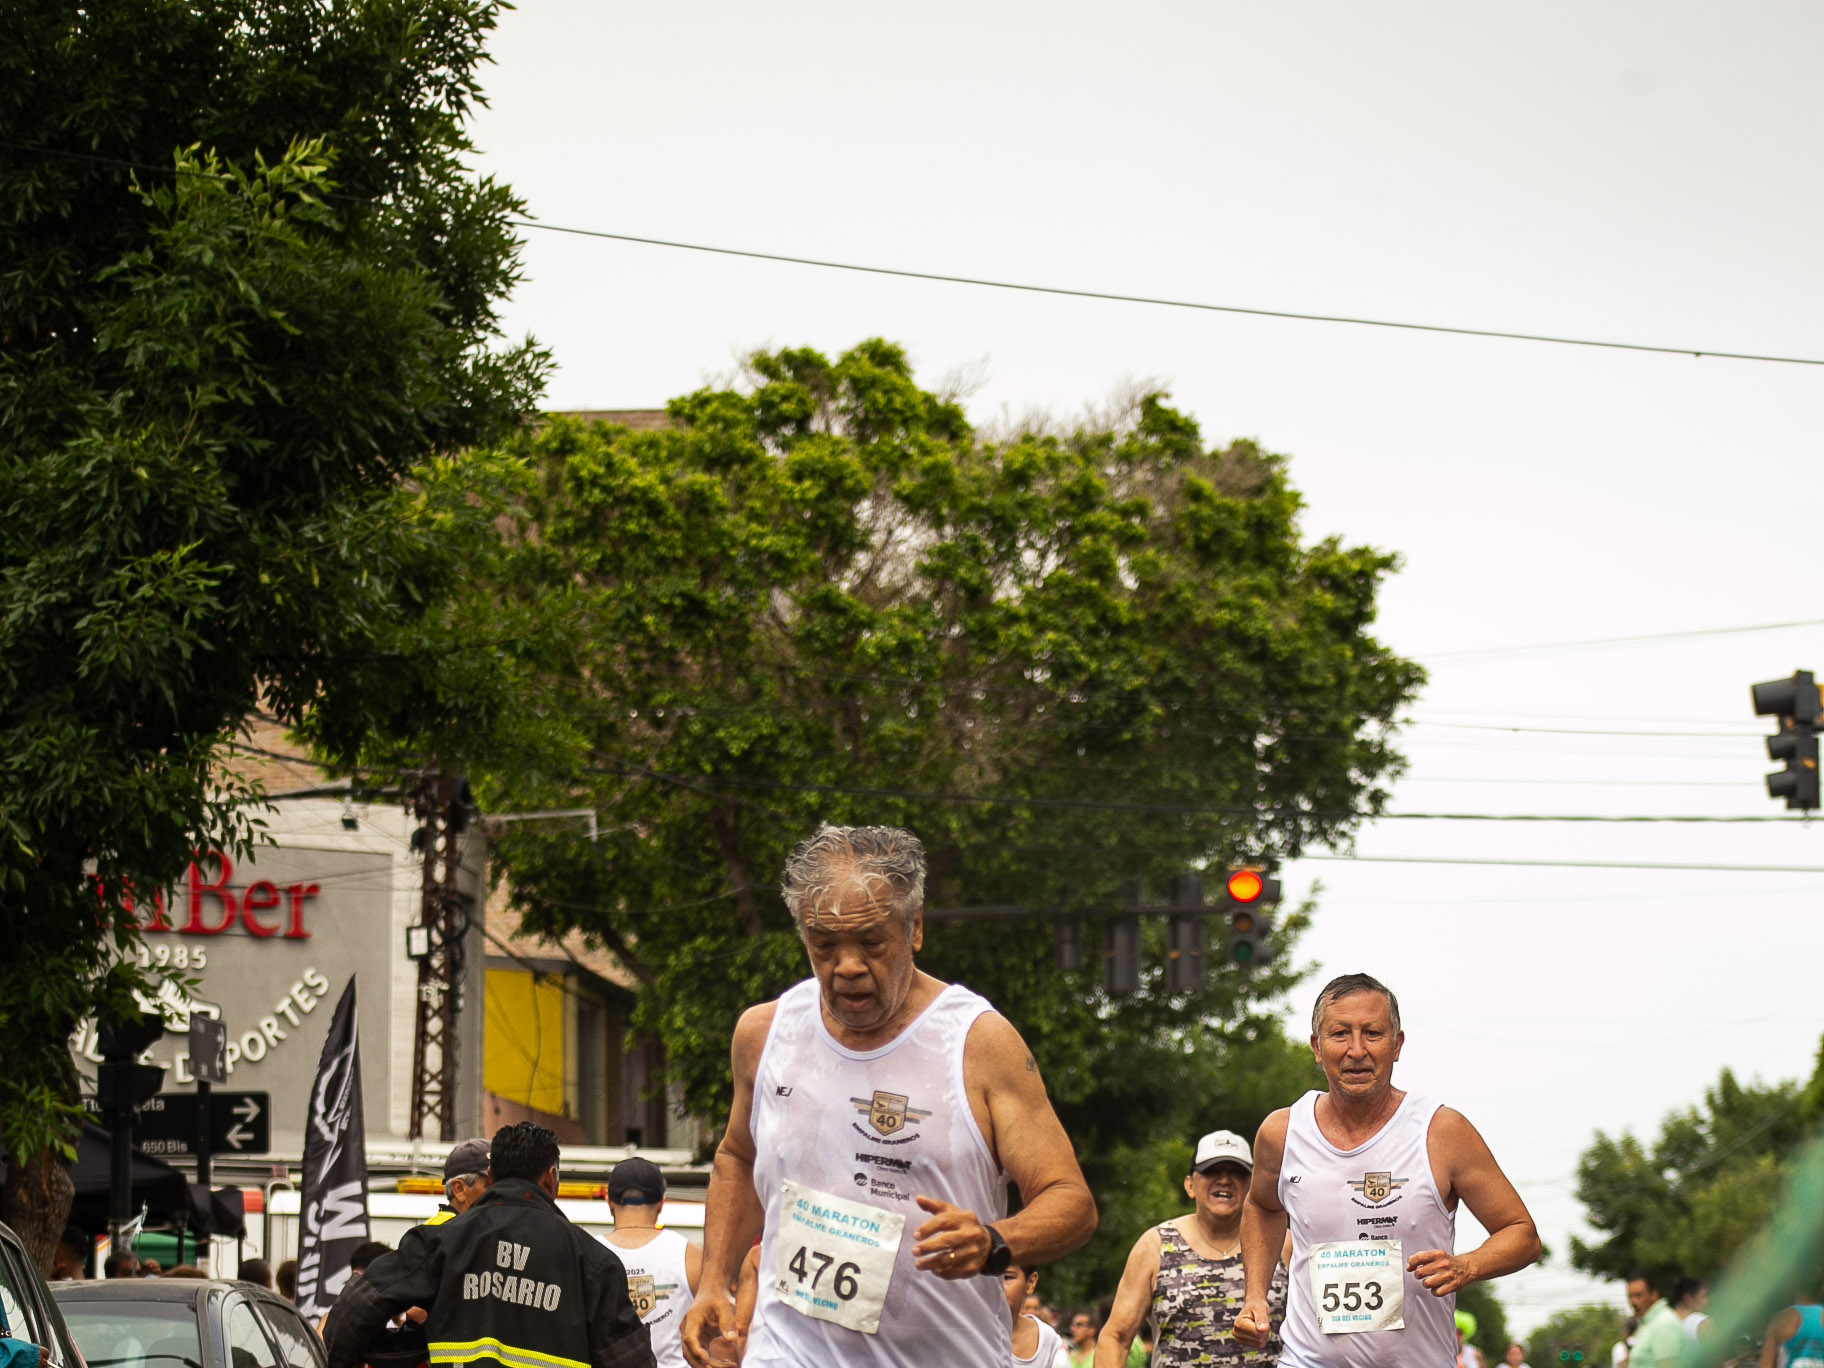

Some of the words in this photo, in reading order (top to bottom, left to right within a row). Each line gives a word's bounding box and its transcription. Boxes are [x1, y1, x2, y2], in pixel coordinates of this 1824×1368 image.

[137, 943, 207, 970] 1985
[876, 1114, 897, 1128] 40
[167, 1140, 188, 1153] Bis
[871, 1178, 896, 1190] Banco
[870, 1187, 910, 1201] Municipal
[1369, 1187, 1385, 1197] 40
[796, 1198, 809, 1211] 40
[811, 1204, 880, 1233] MARATON
[792, 1212, 827, 1233] EMPALME
[829, 1227, 881, 1248] GRANEROS
[496, 1240, 531, 1271] BV
[1320, 1251, 1331, 1259] 40
[1334, 1248, 1386, 1258] MARATON
[625, 1268, 646, 1276] 2025
[1317, 1262, 1349, 1270] EMPALME
[1350, 1260, 1390, 1268] GRANEROS
[789, 1246, 862, 1302] 476
[463, 1271, 562, 1312] ROSARIO
[1322, 1282, 1385, 1312] 553
